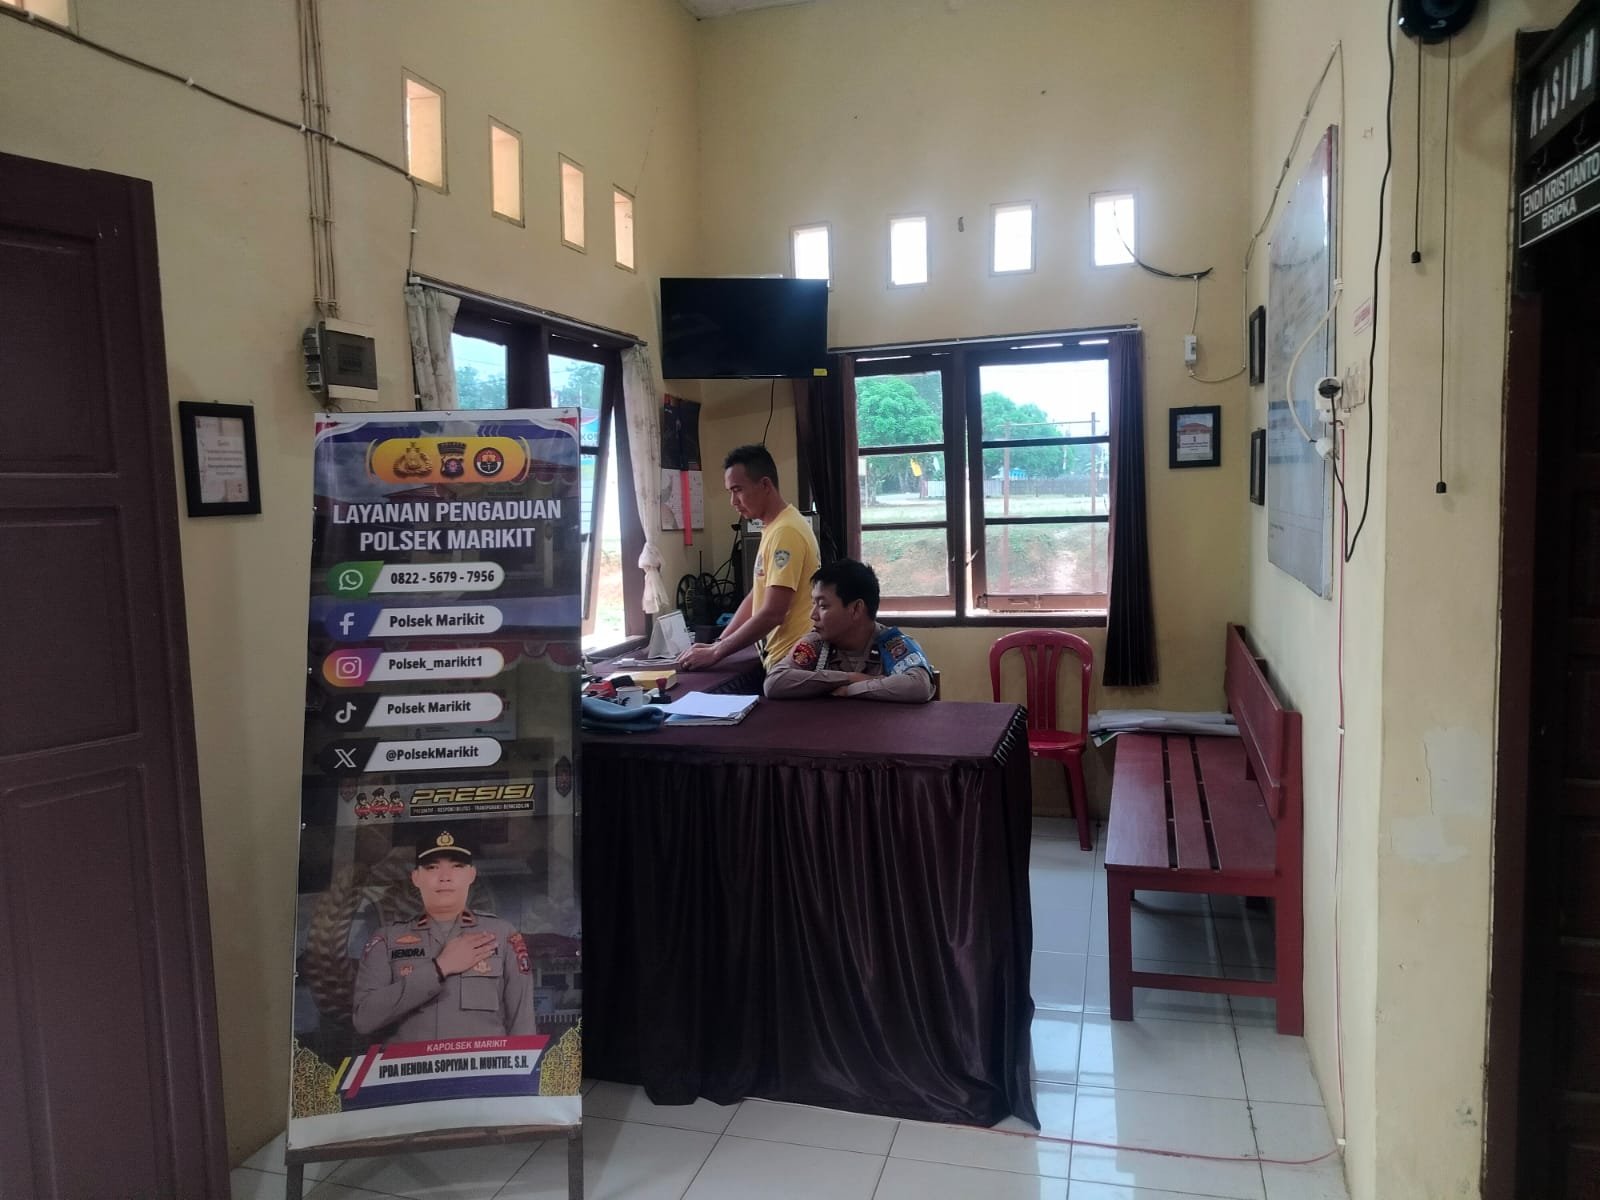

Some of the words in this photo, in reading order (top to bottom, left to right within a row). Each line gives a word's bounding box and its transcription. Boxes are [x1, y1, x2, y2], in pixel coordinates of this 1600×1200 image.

[1524, 187, 1543, 217] ENDI
[1544, 152, 1600, 205] KRISTIANTO
[1542, 196, 1577, 230] BRIPKA
[333, 503, 430, 525] LAYANAN
[436, 499, 561, 522] PENGADUAN
[360, 530, 441, 551] POLSEK
[447, 527, 535, 550] MARIKIT
[390, 572, 419, 585] 0822
[429, 571, 457, 584] 5679
[467, 570, 495, 583] 7956
[389, 615, 432, 628] Polsek
[436, 613, 485, 626] Marikit
[388, 656, 483, 671] Polsek_marikit1
[387, 702, 425, 715] Polsek
[428, 700, 471, 713] Marikit
[385, 747, 479, 762] @PolsekMarikit
[410, 784, 535, 804] PRESISI
[426, 1041, 472, 1052] KAPOLSEK
[473, 1039, 508, 1049] MARIKIT
[379, 1064, 399, 1079] IPDA
[400, 1060, 433, 1076] HENDRA
[434, 1057, 468, 1073] SOPIYAN
